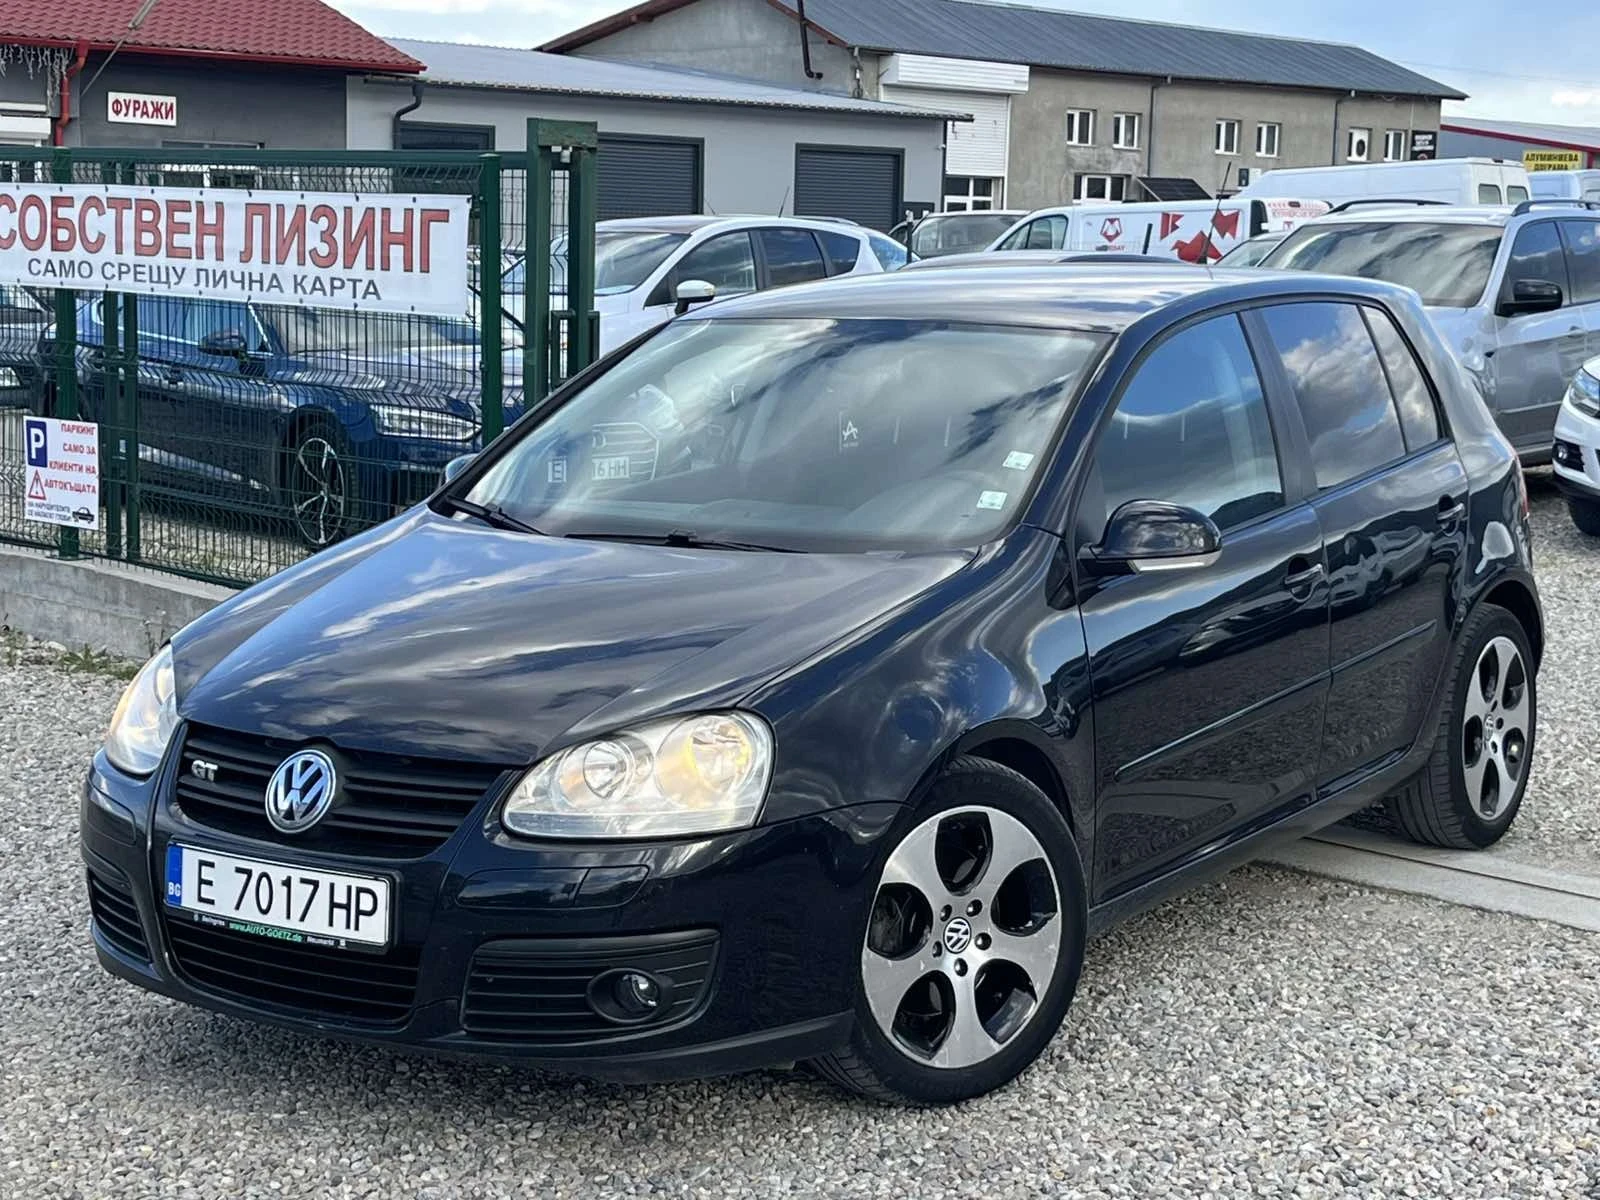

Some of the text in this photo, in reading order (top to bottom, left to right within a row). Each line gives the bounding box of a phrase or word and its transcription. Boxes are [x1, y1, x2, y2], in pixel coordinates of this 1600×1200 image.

[111, 97, 174, 121] ФУРАЖИ
[0, 194, 450, 274] СОБСТВЕН ЛИЗИНГ
[27, 257, 382, 301] САМО СРЕЩУ ЛИЧНА КАРТА
[61, 423, 96, 436] ПАРКИНГ
[63, 442, 96, 455] САМО ЗА
[49, 461, 96, 475] КЛИЕНТИ НА
[44, 479, 96, 495] АВТОКЪЩАТА
[191, 759, 219, 782] GT
[168, 881, 181, 898] BG
[198, 859, 378, 931] E 7017 HP
